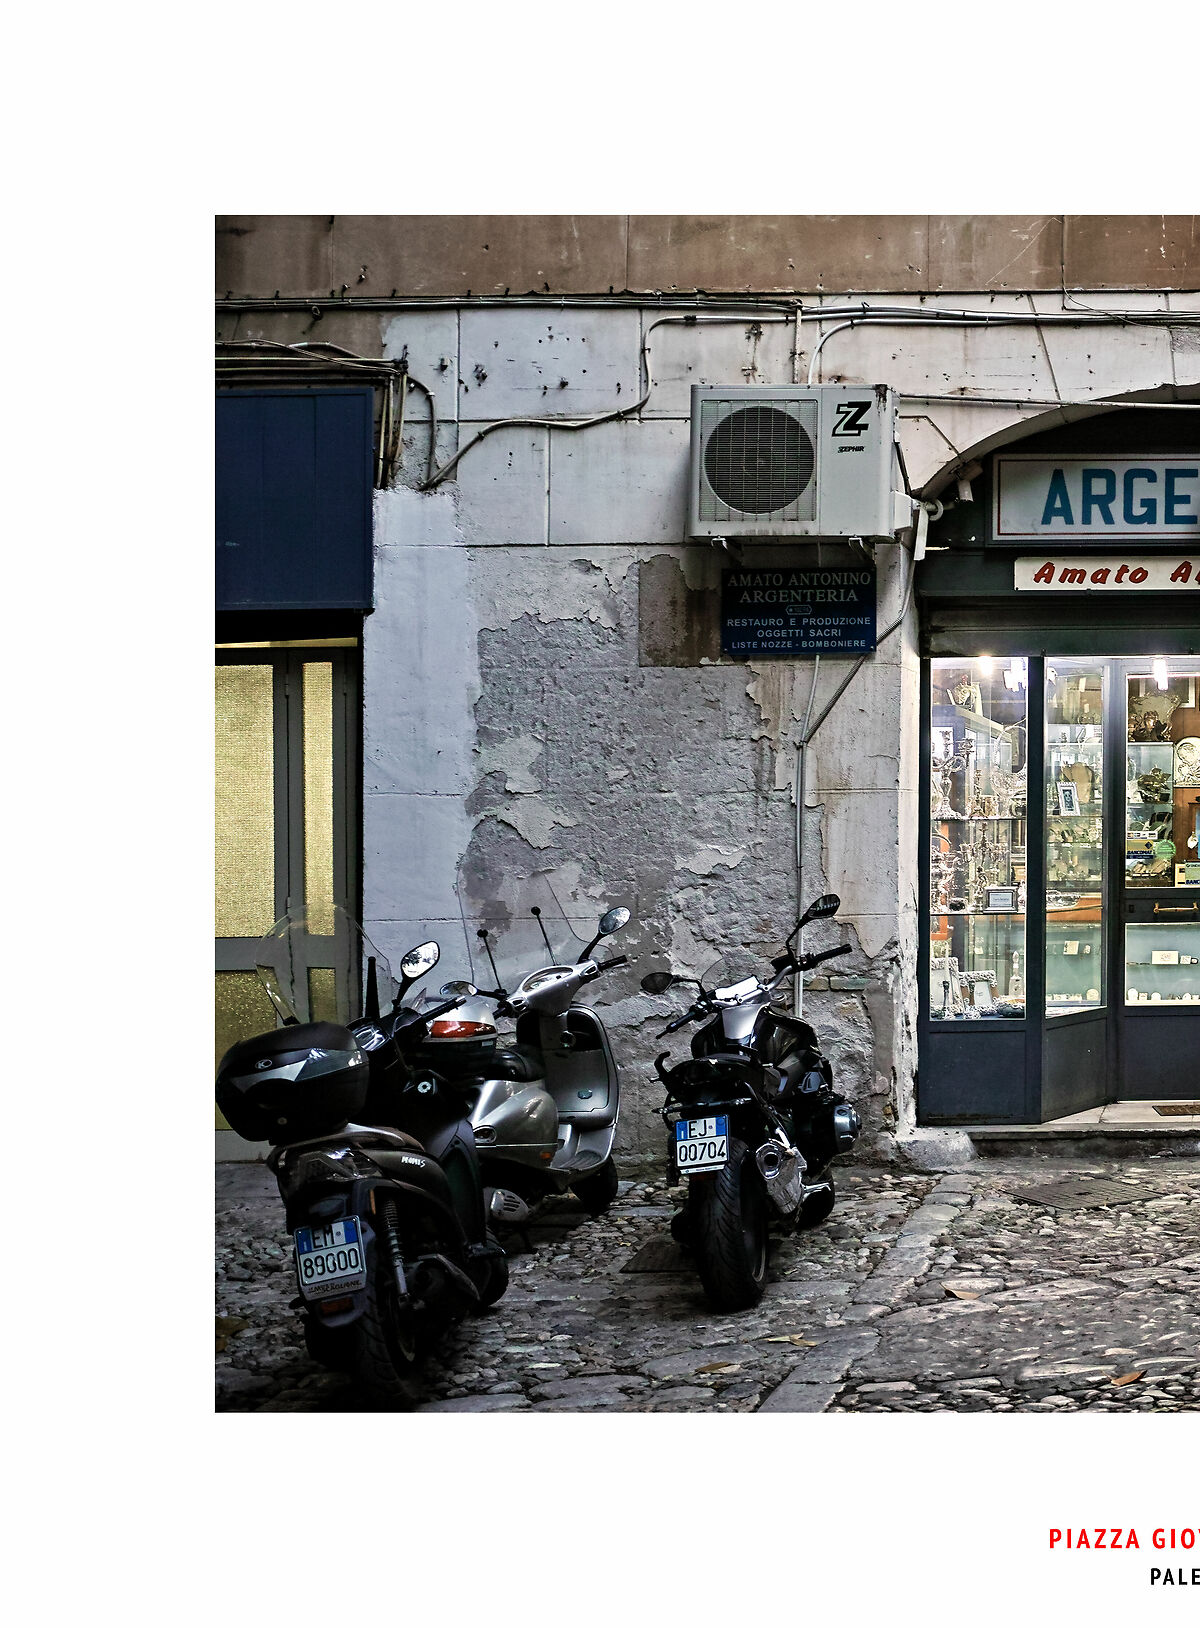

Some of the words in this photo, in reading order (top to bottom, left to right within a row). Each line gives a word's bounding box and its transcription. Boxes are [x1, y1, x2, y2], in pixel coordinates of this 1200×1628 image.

[727, 573, 783, 587] AMATO
[788, 572, 871, 586] ANTONINO
[1032, 560, 1149, 585] Amato
[739, 589, 859, 603] ARGENTERIA
[727, 618, 784, 627] RESTAURO
[789, 618, 796, 626] E
[802, 617, 871, 626] PRODUZIONE
[757, 629, 803, 638] OGGETTI
[809, 629, 841, 637] SACRI
[731, 641, 758, 649] LISTE
[801, 640, 866, 648] BOMBONIERE
[688, 1119, 707, 1139] EJ
[679, 1139, 726, 1162] 00704
[313, 1224, 335, 1249] EM
